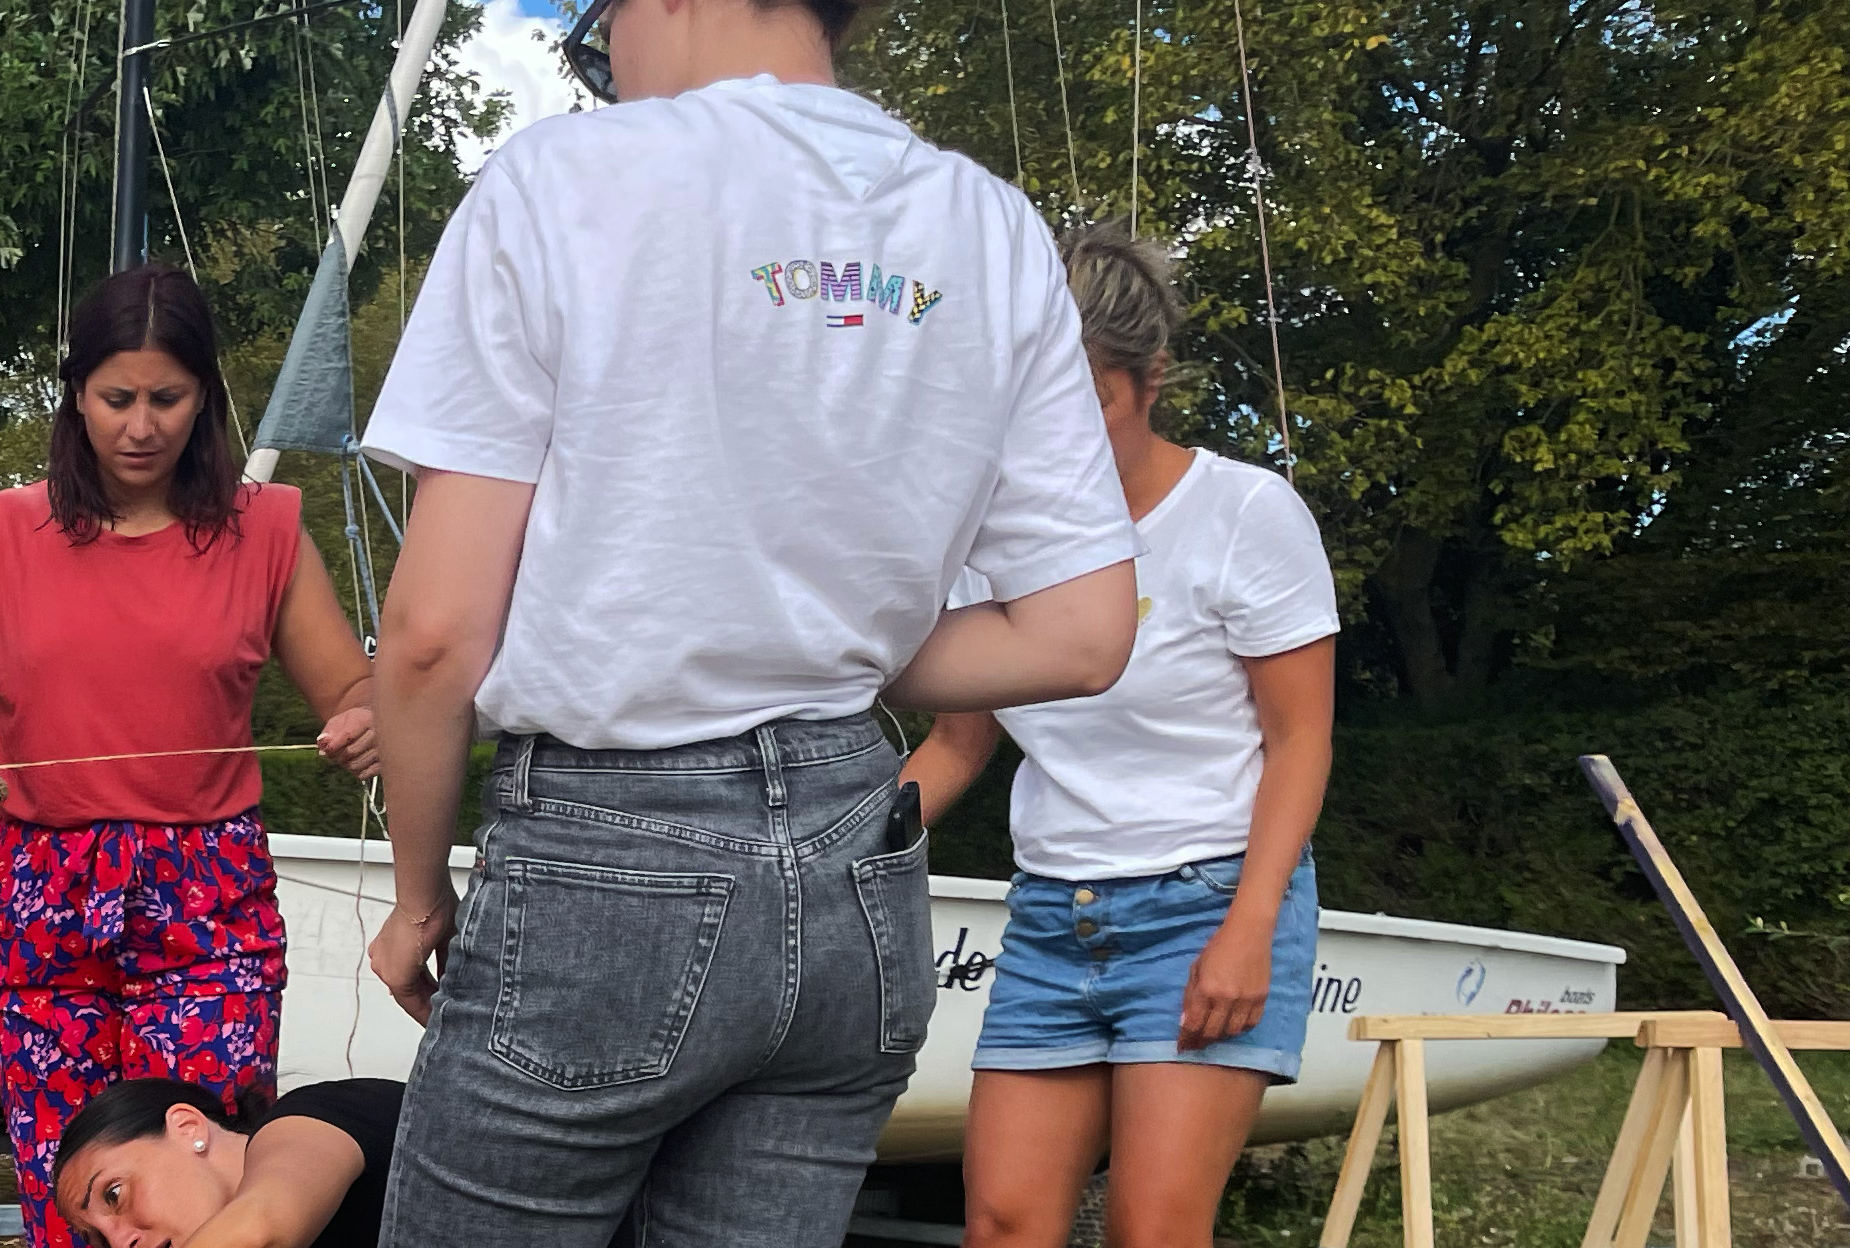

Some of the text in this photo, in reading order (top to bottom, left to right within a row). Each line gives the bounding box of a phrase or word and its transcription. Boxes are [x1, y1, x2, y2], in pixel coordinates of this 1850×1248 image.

[750, 259, 943, 326] TOMMY
[936, 927, 1362, 1013] de ine
